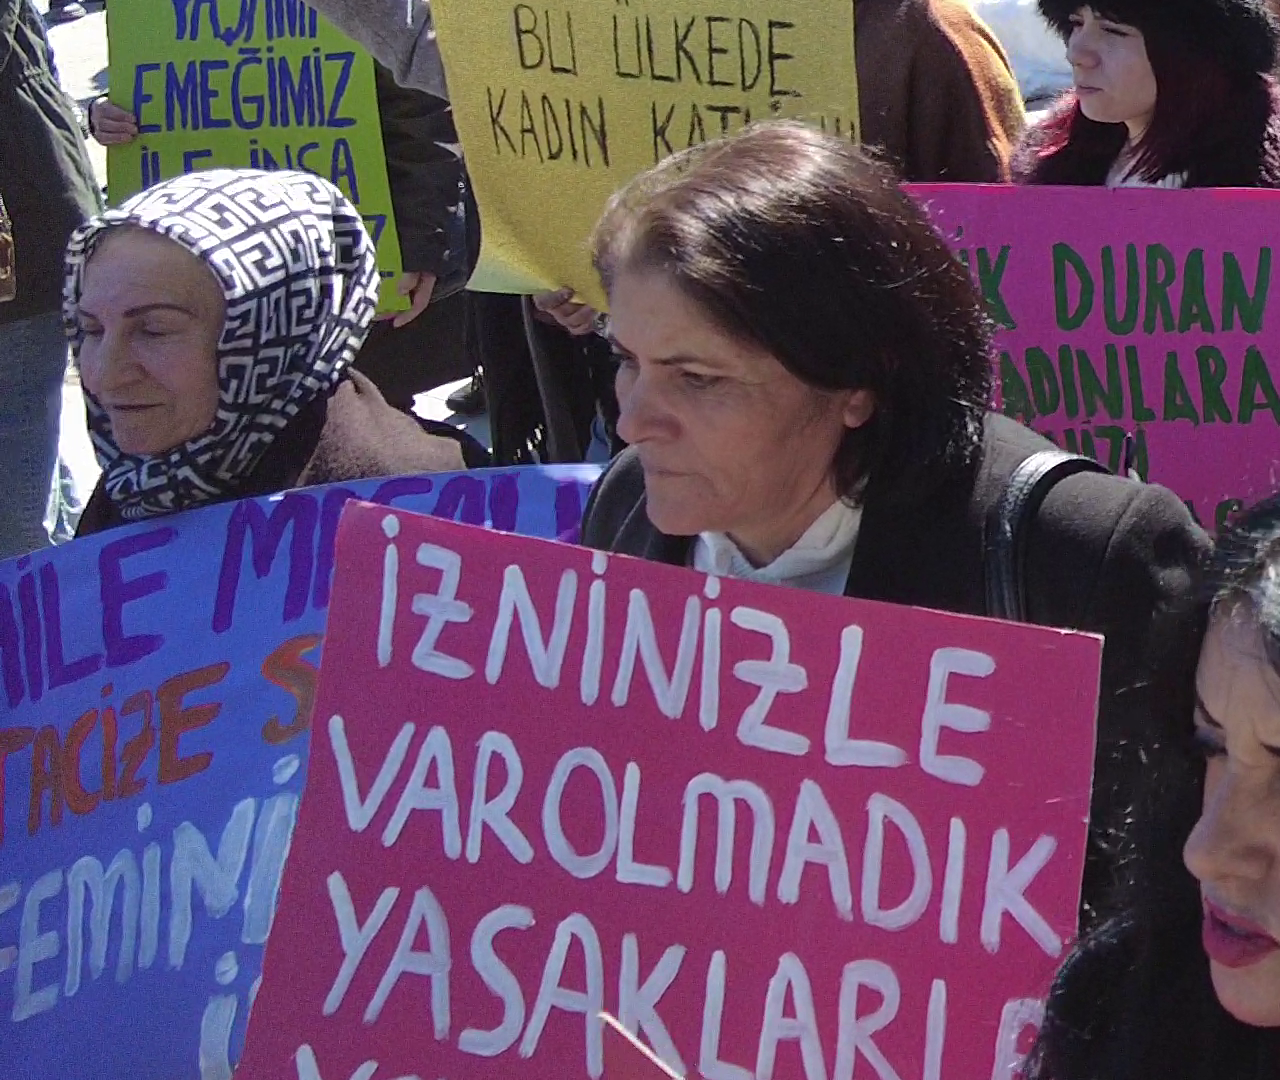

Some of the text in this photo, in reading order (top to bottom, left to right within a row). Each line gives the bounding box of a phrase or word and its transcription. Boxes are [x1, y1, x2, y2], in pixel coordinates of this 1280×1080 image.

[133, 46, 358, 134] EMEĞİMİZ
[513, 3, 578, 77] BU
[486, 86, 611, 169] KADIN
[1052, 241, 1272, 335] DURAN
[376, 513, 997, 788] İZNİNİZLE
[0, 753, 300, 1022] EMİNİ
[328, 714, 1063, 958] VAROLMADIK
[321, 870, 948, 1080] YASAKLARI
